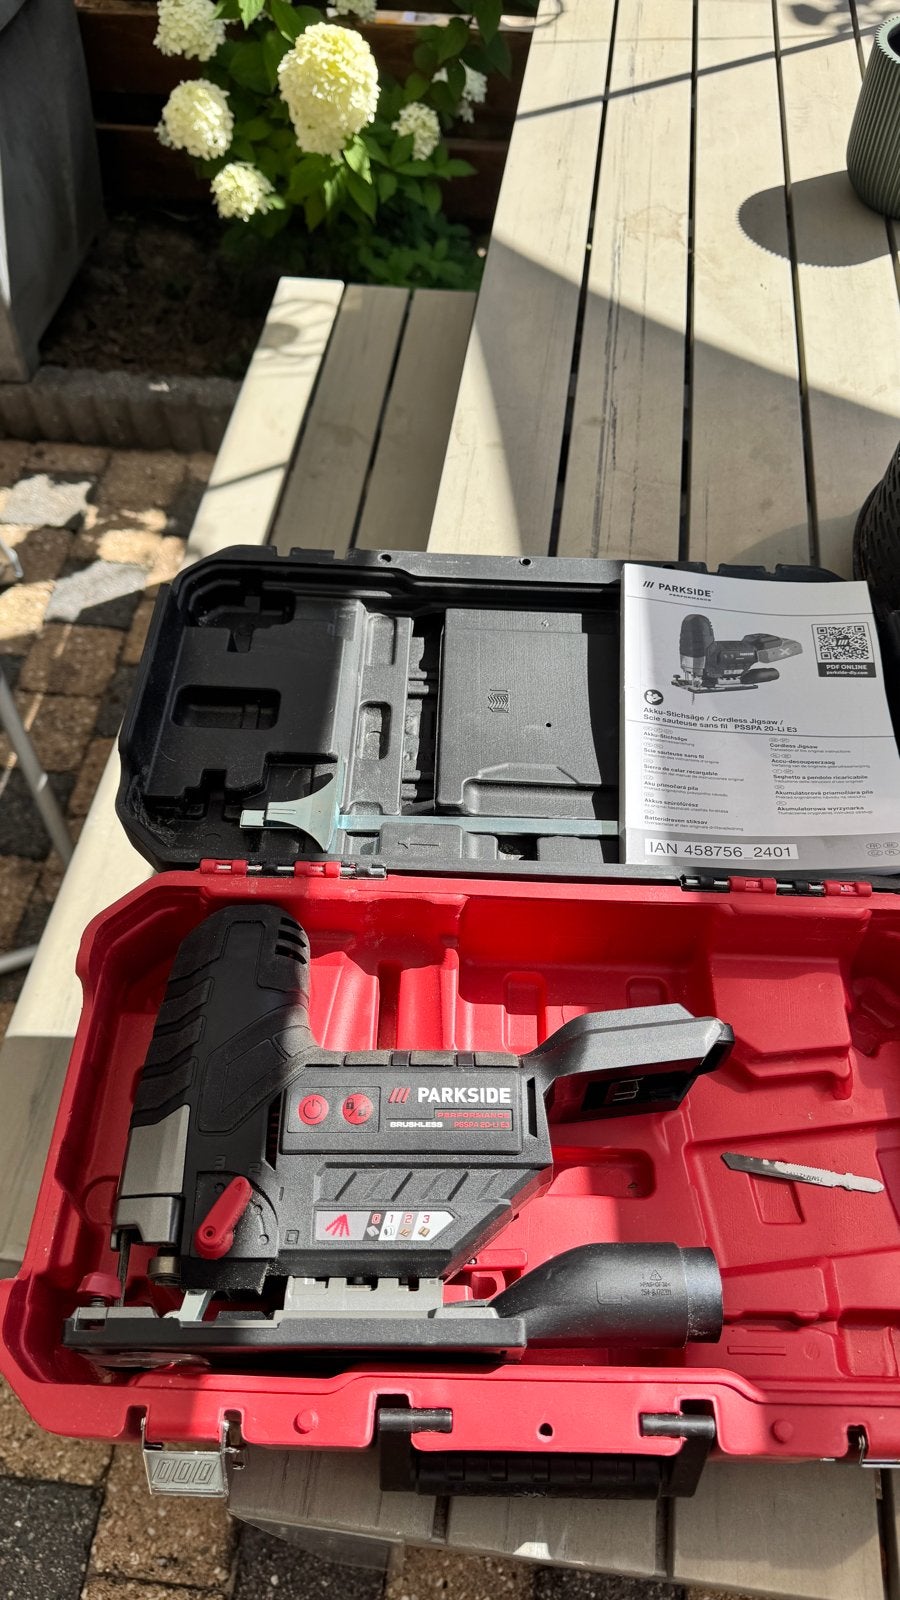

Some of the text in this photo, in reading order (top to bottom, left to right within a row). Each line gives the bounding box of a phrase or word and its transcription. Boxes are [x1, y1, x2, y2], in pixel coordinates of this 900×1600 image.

[658, 582, 711, 598] PARKSIDE
[644, 707, 704, 722] Akku-Stichsäge
[712, 716, 748, 724] Cordless
[750, 718, 778, 726] Jigsaw
[662, 718, 698, 728] sauteuse
[650, 841, 790, 859] IAN 458756_2401
[417, 1087, 512, 1104] PARKSIDE
[371, 1214, 430, 1224] 0 1 2 3
